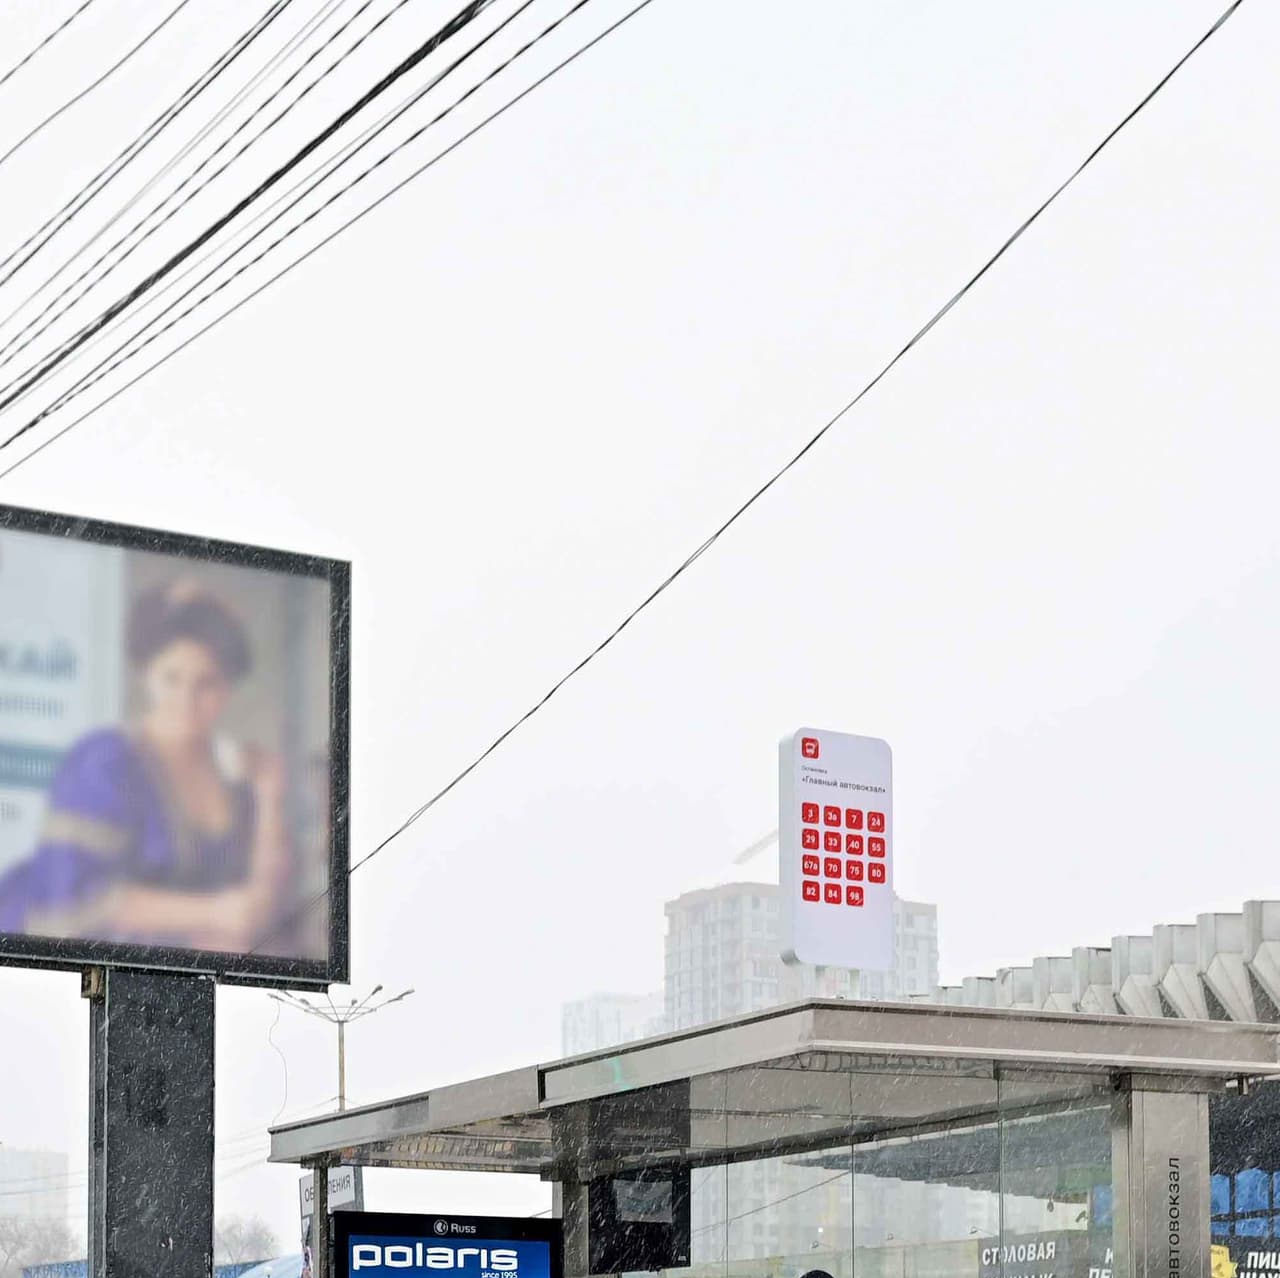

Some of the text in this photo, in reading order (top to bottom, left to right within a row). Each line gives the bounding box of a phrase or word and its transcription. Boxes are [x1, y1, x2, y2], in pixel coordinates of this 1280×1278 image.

[851, 815, 857, 823] 7
[871, 818, 880, 826] 24
[806, 834, 815, 843] 29
[850, 841, 860, 849] 40
[828, 863, 838, 872] 70
[451, 1223, 476, 1234] Russ
[352, 1242, 518, 1271] polaris
[982, 1241, 1056, 1266] СТОЛОВАЯ
[481, 1271, 499, 1278] since
